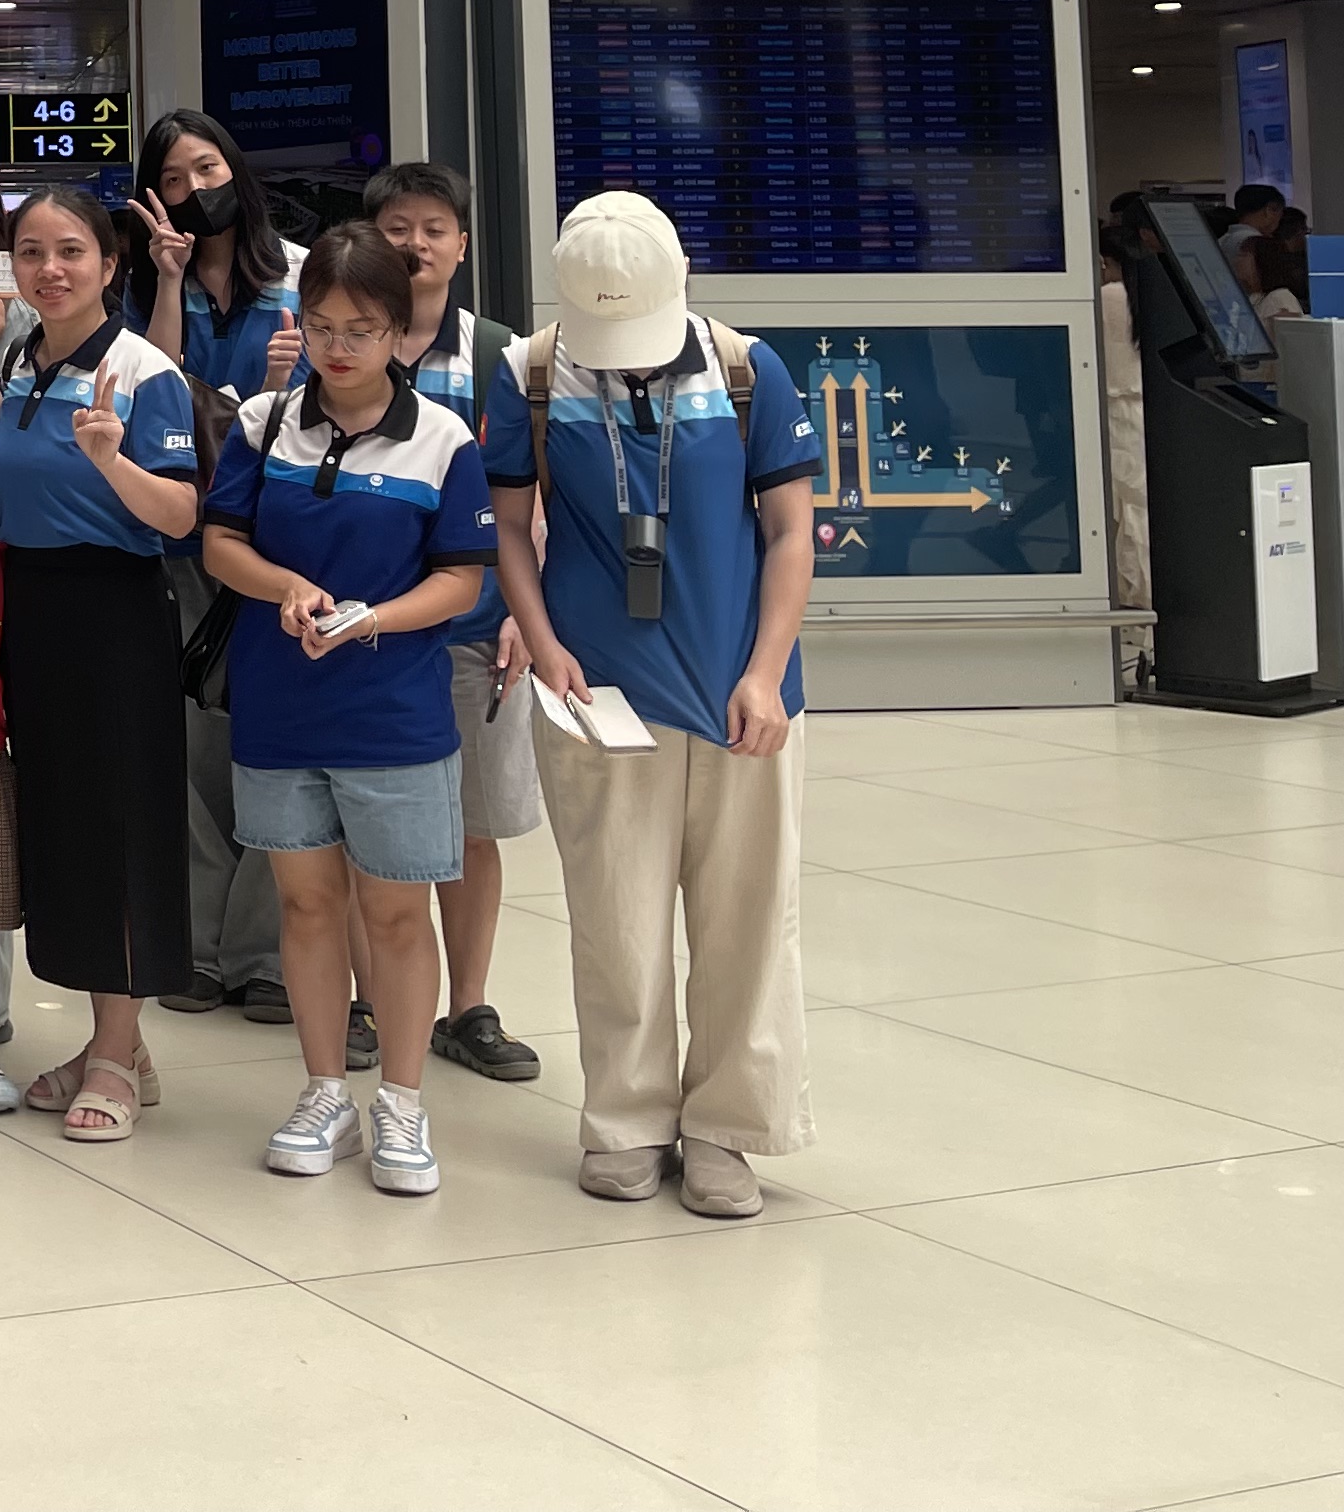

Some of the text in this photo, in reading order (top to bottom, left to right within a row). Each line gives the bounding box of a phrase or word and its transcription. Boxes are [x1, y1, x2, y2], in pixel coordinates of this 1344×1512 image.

[223, 28, 358, 58] MORE OPINIONS
[257, 59, 321, 82] BETTER
[230, 83, 353, 111] IMPROVEMENT
[33, 101, 75, 122] 4-6
[33, 136, 75, 157] 1-3
